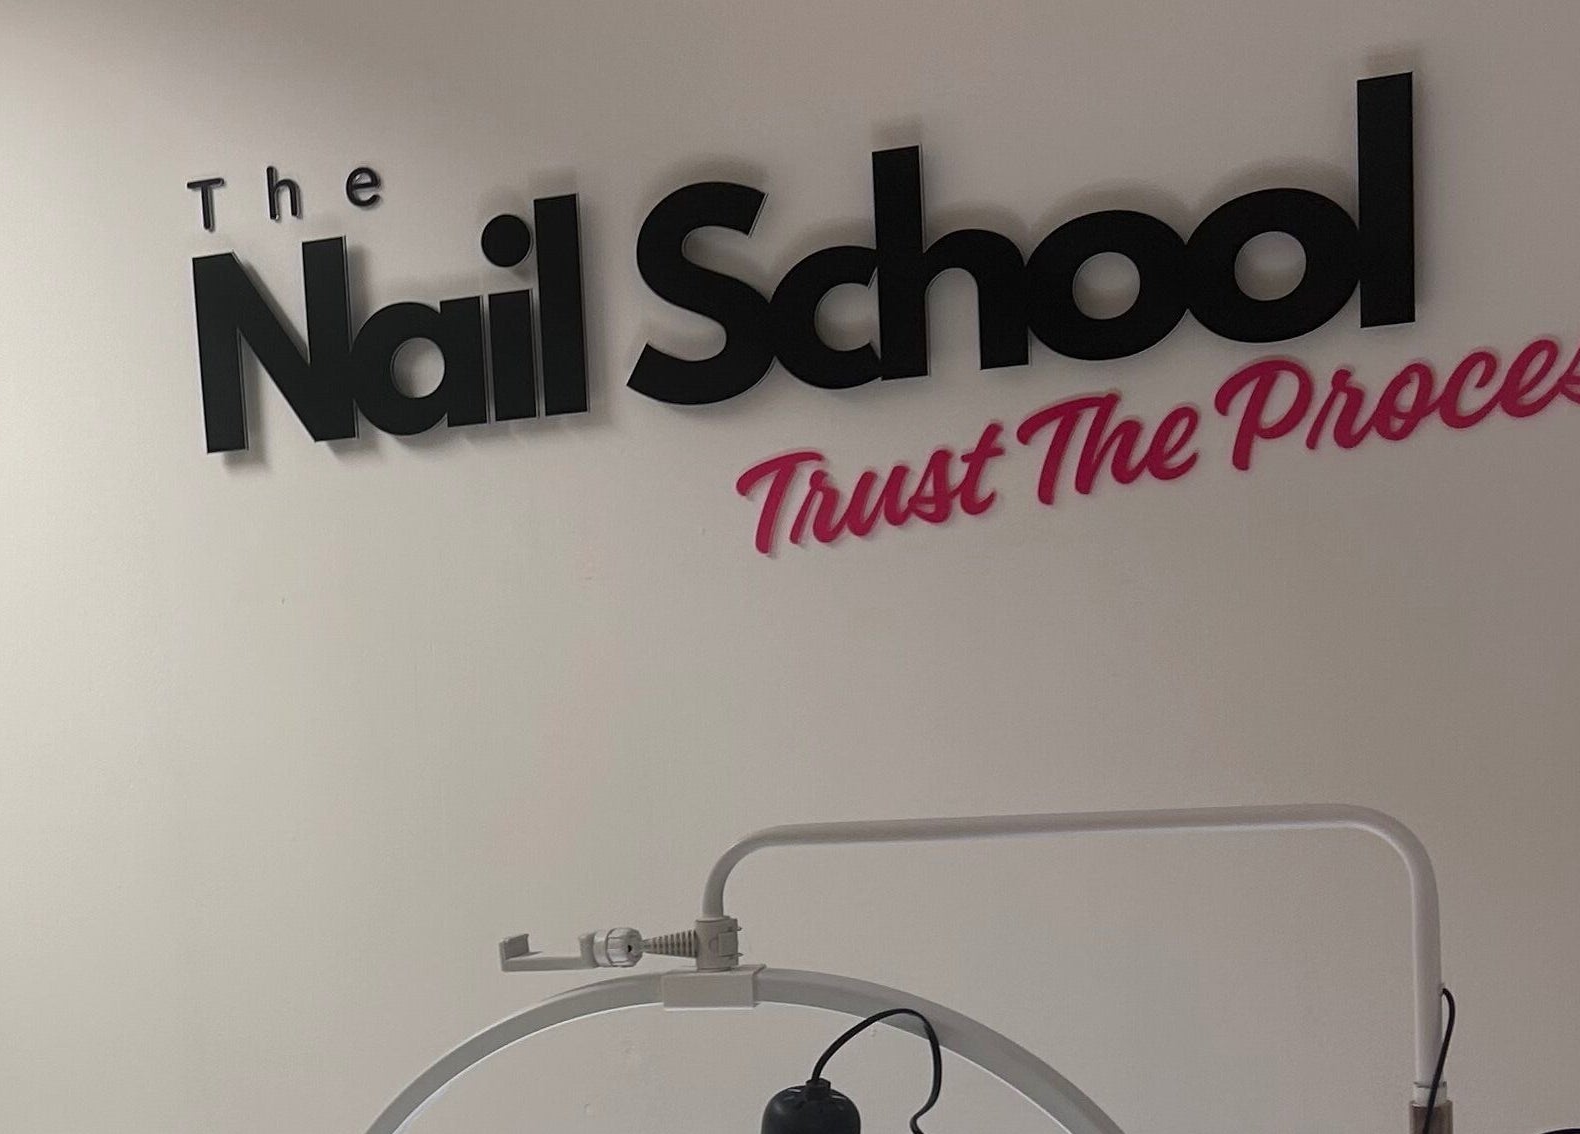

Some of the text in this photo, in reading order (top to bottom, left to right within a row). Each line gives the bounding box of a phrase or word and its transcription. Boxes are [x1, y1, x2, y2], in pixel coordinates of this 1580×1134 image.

[186, 165, 381, 231] The
[192, 71, 1417, 453] Nail School
[736, 422, 1004, 555] Trust
[1018, 393, 1199, 505] The
